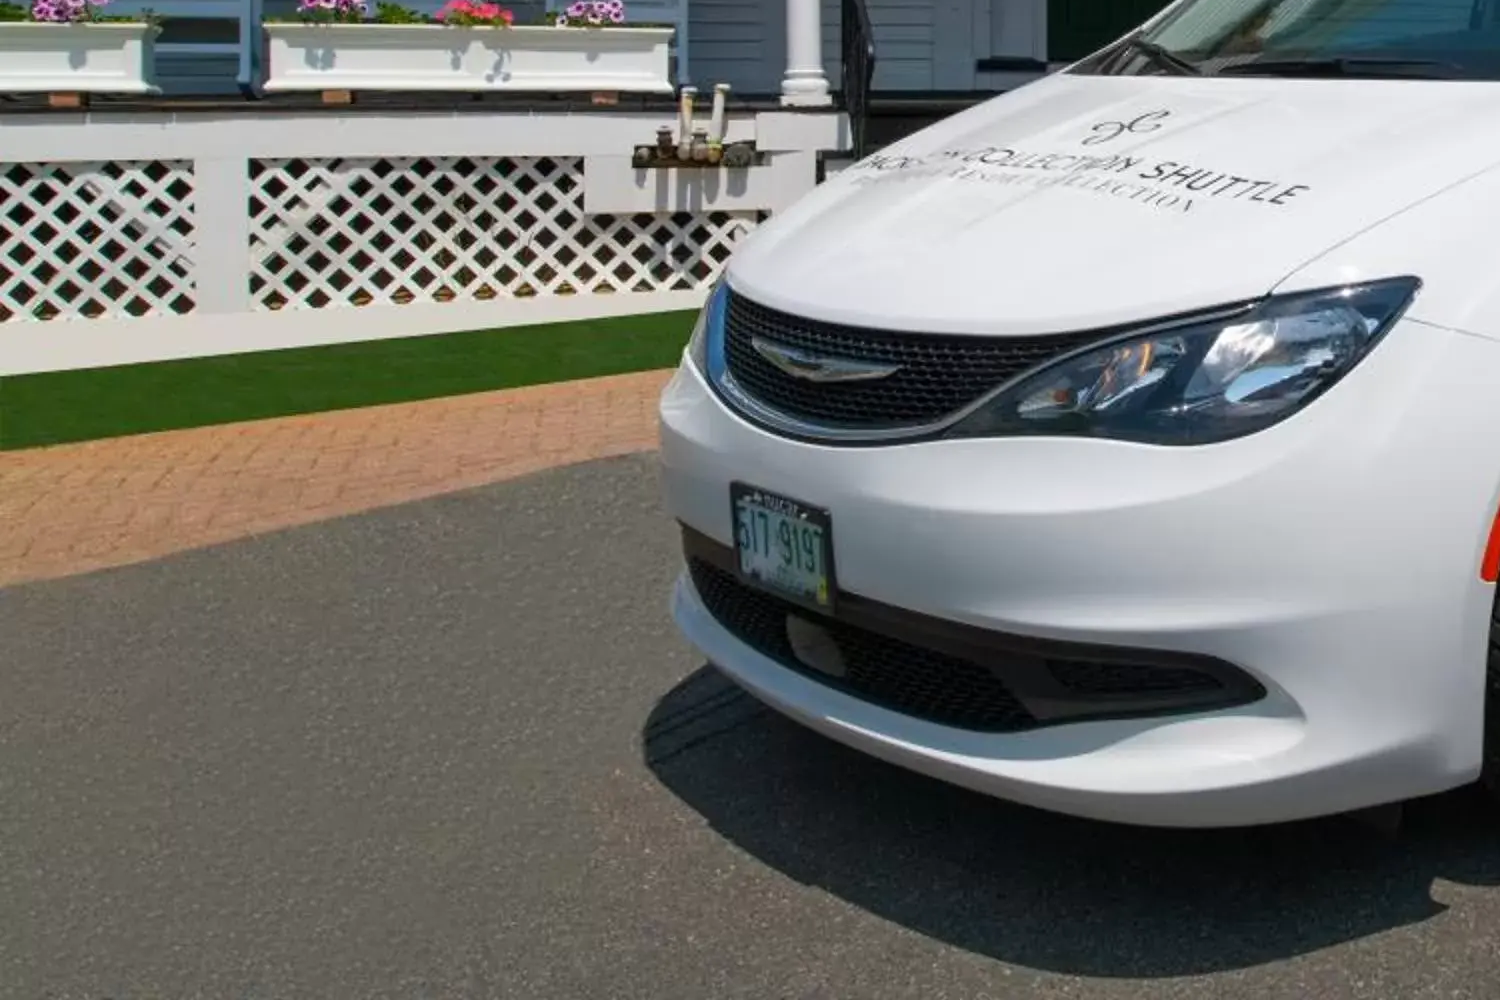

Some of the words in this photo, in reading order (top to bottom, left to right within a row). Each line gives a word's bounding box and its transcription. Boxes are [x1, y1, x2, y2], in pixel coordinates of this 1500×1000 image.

[960, 147, 1147, 174] COLLECTION
[1138, 161, 1312, 206] SHUTTLE
[779, 520, 823, 573] 919
